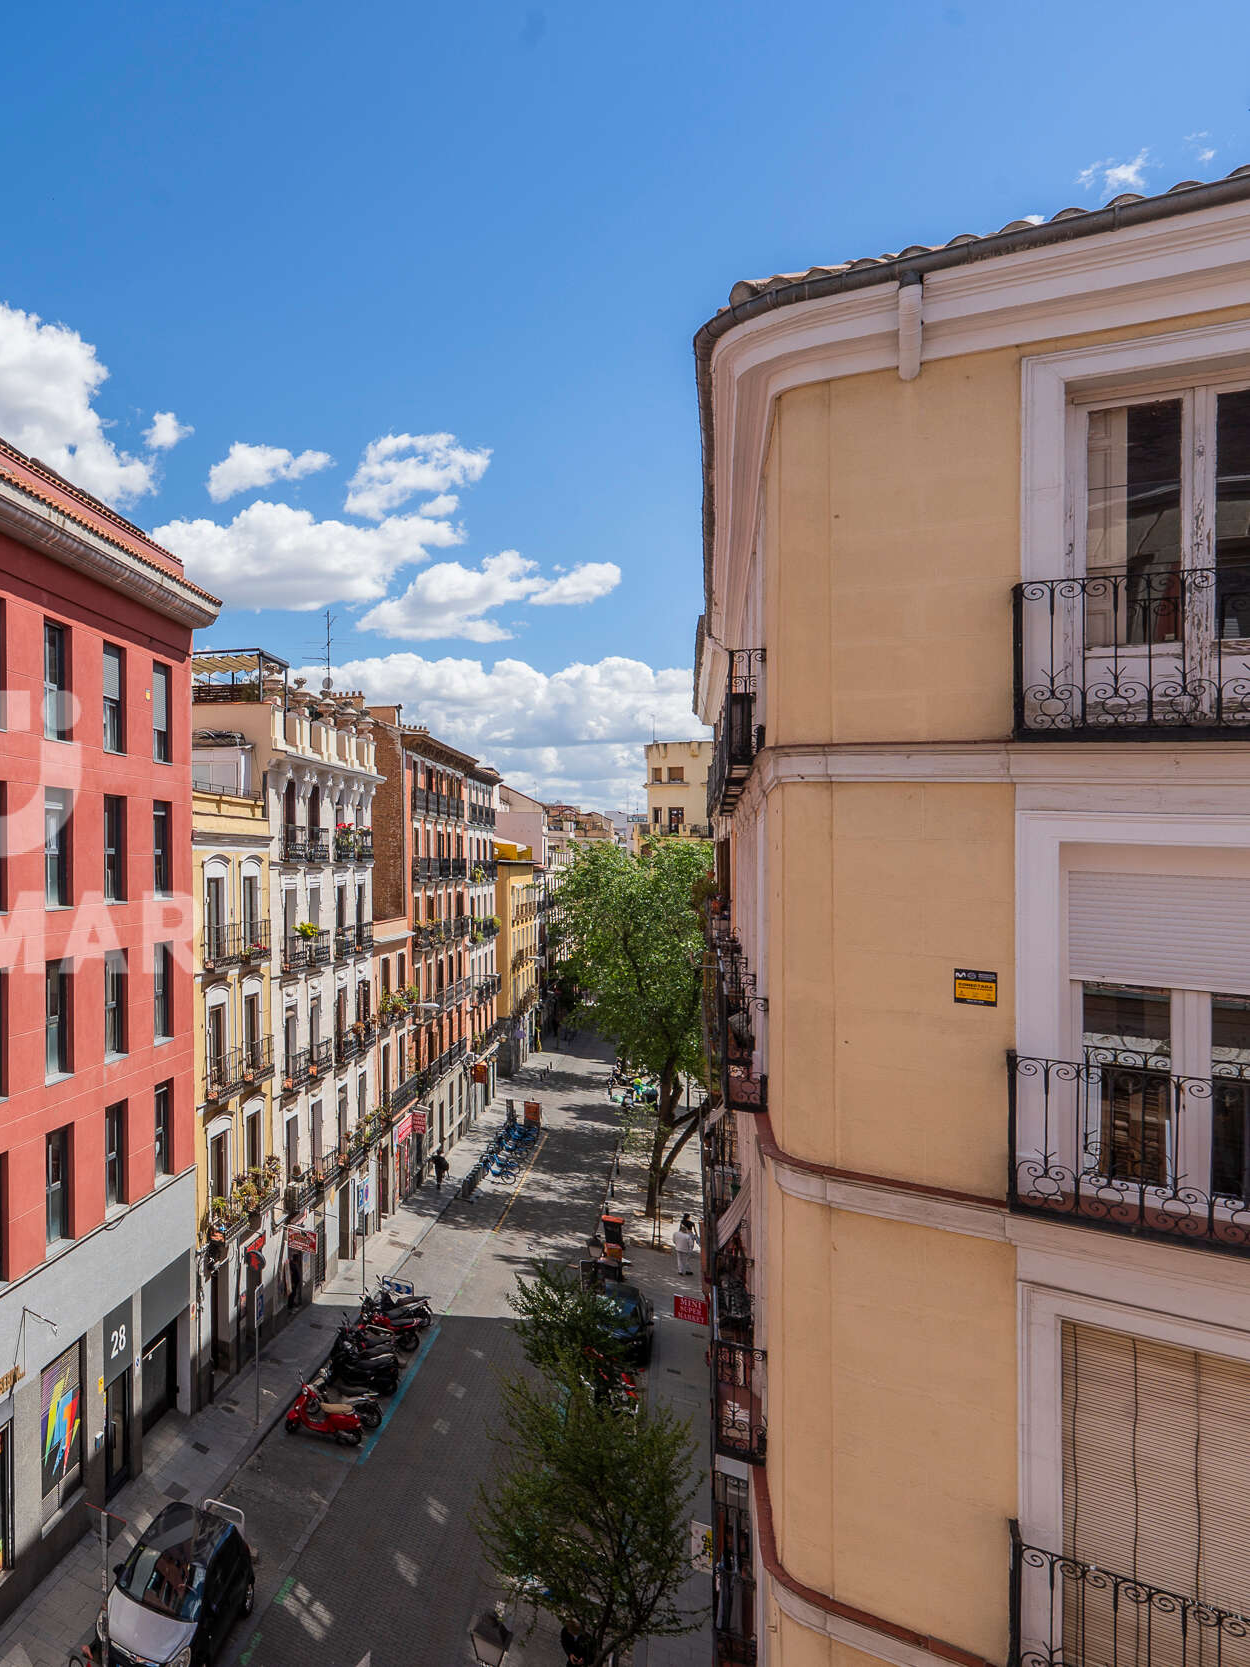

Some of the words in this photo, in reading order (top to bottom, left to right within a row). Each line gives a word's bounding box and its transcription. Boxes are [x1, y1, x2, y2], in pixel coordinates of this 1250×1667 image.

[680, 1296, 702, 1309] MINI
[679, 1305, 702, 1315] SUPER
[677, 1311, 704, 1323] MARKET
[110, 1324, 126, 1360] 28
